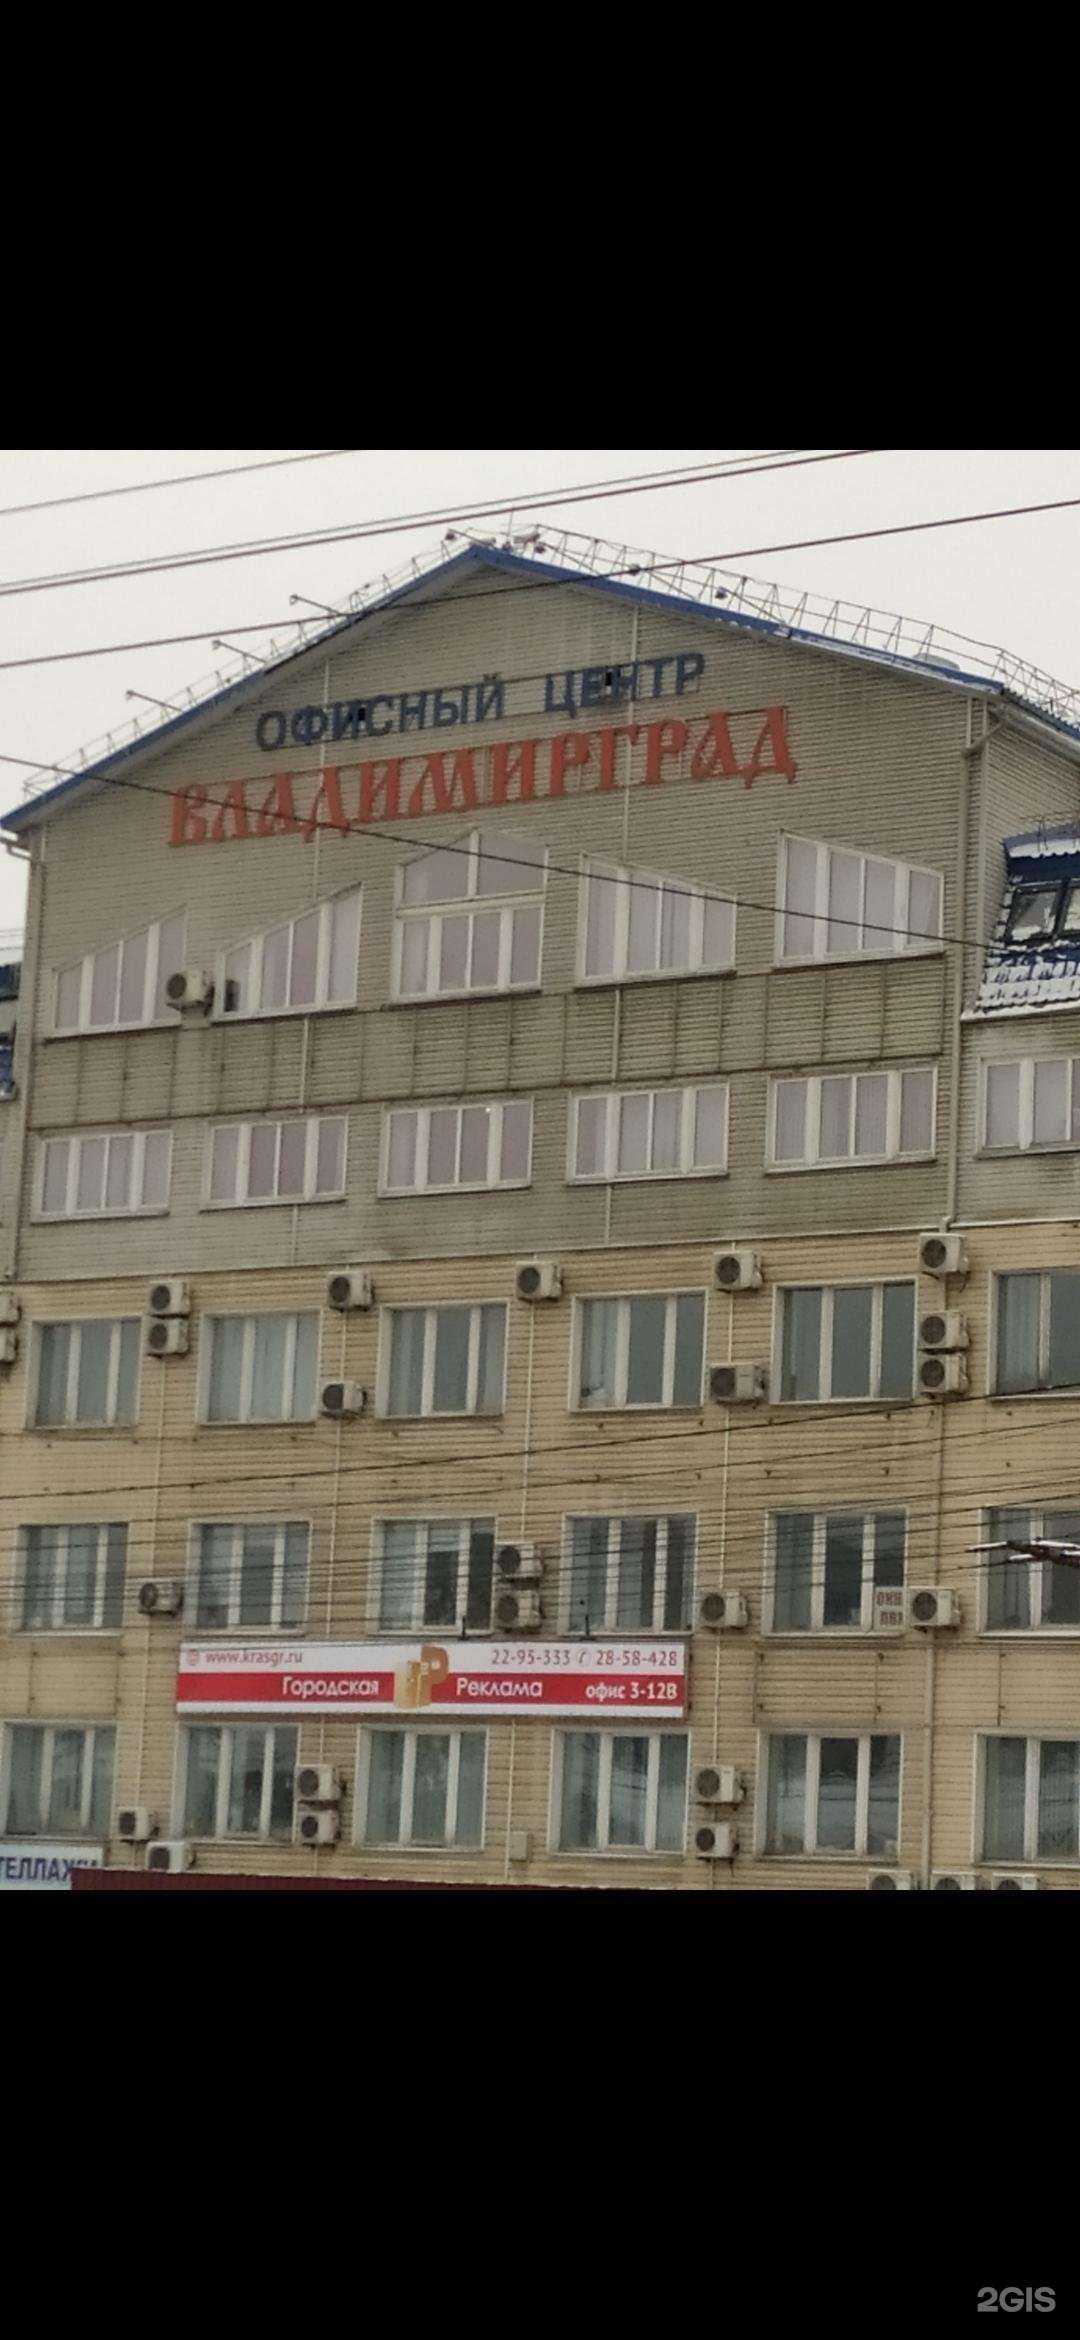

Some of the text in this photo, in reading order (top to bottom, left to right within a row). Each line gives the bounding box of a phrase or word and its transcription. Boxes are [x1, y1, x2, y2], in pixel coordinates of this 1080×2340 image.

[256, 653, 705, 752] ОФИСНЫЙ ЦЕНТР
[169, 707, 796, 846] ВЛАДИМИРГРАД
[205, 1650, 303, 1666] www.krasgr.ru
[491, 1649, 677, 1666] 22-95-333 28-58-428
[283, 1676, 543, 1699] Городская Реклама
[585, 1684, 625, 1702] офис
